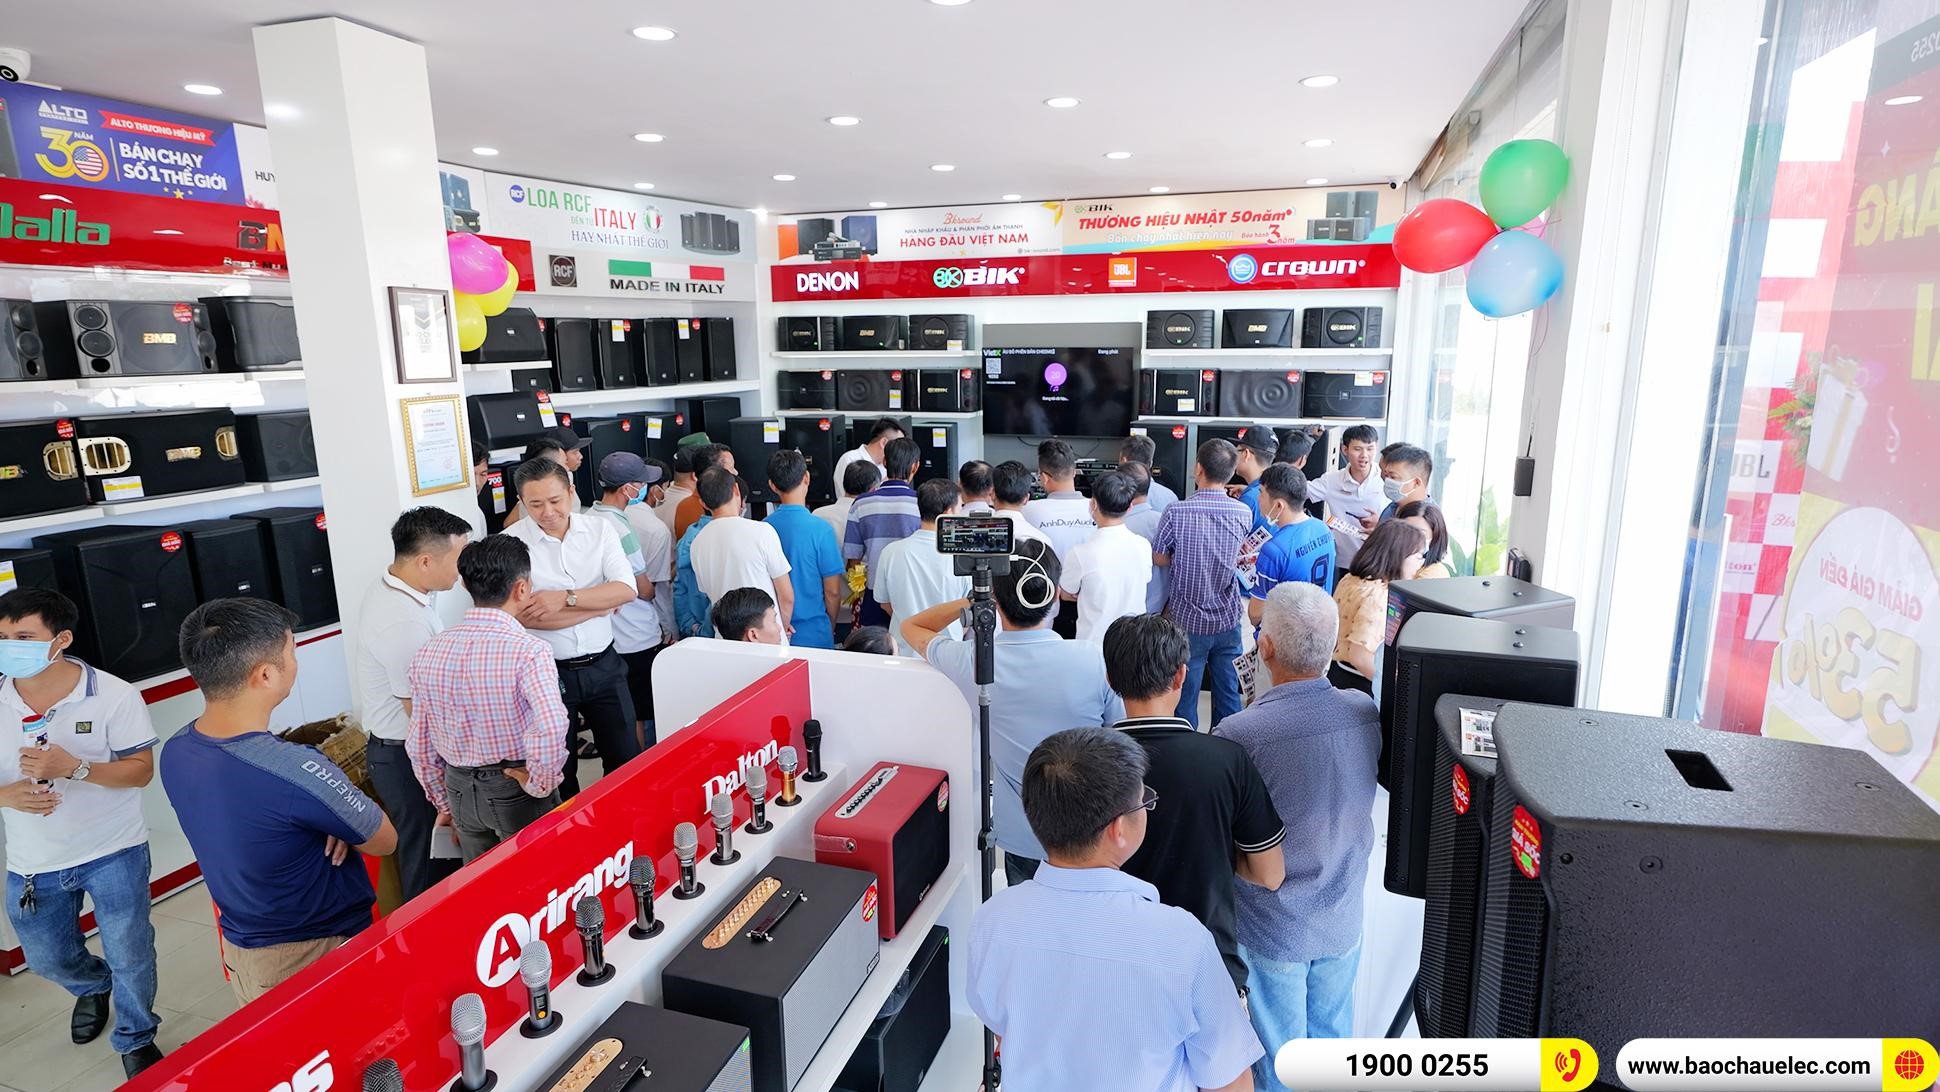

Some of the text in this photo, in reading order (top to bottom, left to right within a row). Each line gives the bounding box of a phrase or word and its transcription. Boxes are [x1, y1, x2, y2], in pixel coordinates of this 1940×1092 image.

[38, 99, 88, 120] ALTO
[110, 117, 134, 129] ALTO
[74, 130, 94, 141] NĂM
[34, 126, 109, 182] 30
[118, 141, 204, 170] BÁN CHẠY
[123, 160, 147, 180] SỐ
[149, 165, 160, 182] 1
[527, 187, 592, 213] LOA RCF
[594, 207, 637, 230] ITALY
[1079, 214, 1142, 230] THƯƠNG
[1145, 211, 1181, 230] HIỆU
[1184, 208, 1228, 228] NHẬT
[571, 230, 594, 243] HAY
[998, 233, 1029, 244] NAM
[1266, 223, 1281, 244] 3
[554, 264, 573, 279] RCF
[963, 266, 1020, 286] BIK
[1113, 263, 1131, 276] JBL
[1261, 259, 1358, 276] crown
[609, 279, 725, 294] MADE IN ITALY
[796, 270, 859, 293] DENON
[143, 332, 177, 344] BMB
[701, 739, 779, 815] Dalton
[475, 840, 634, 988] Arirang
